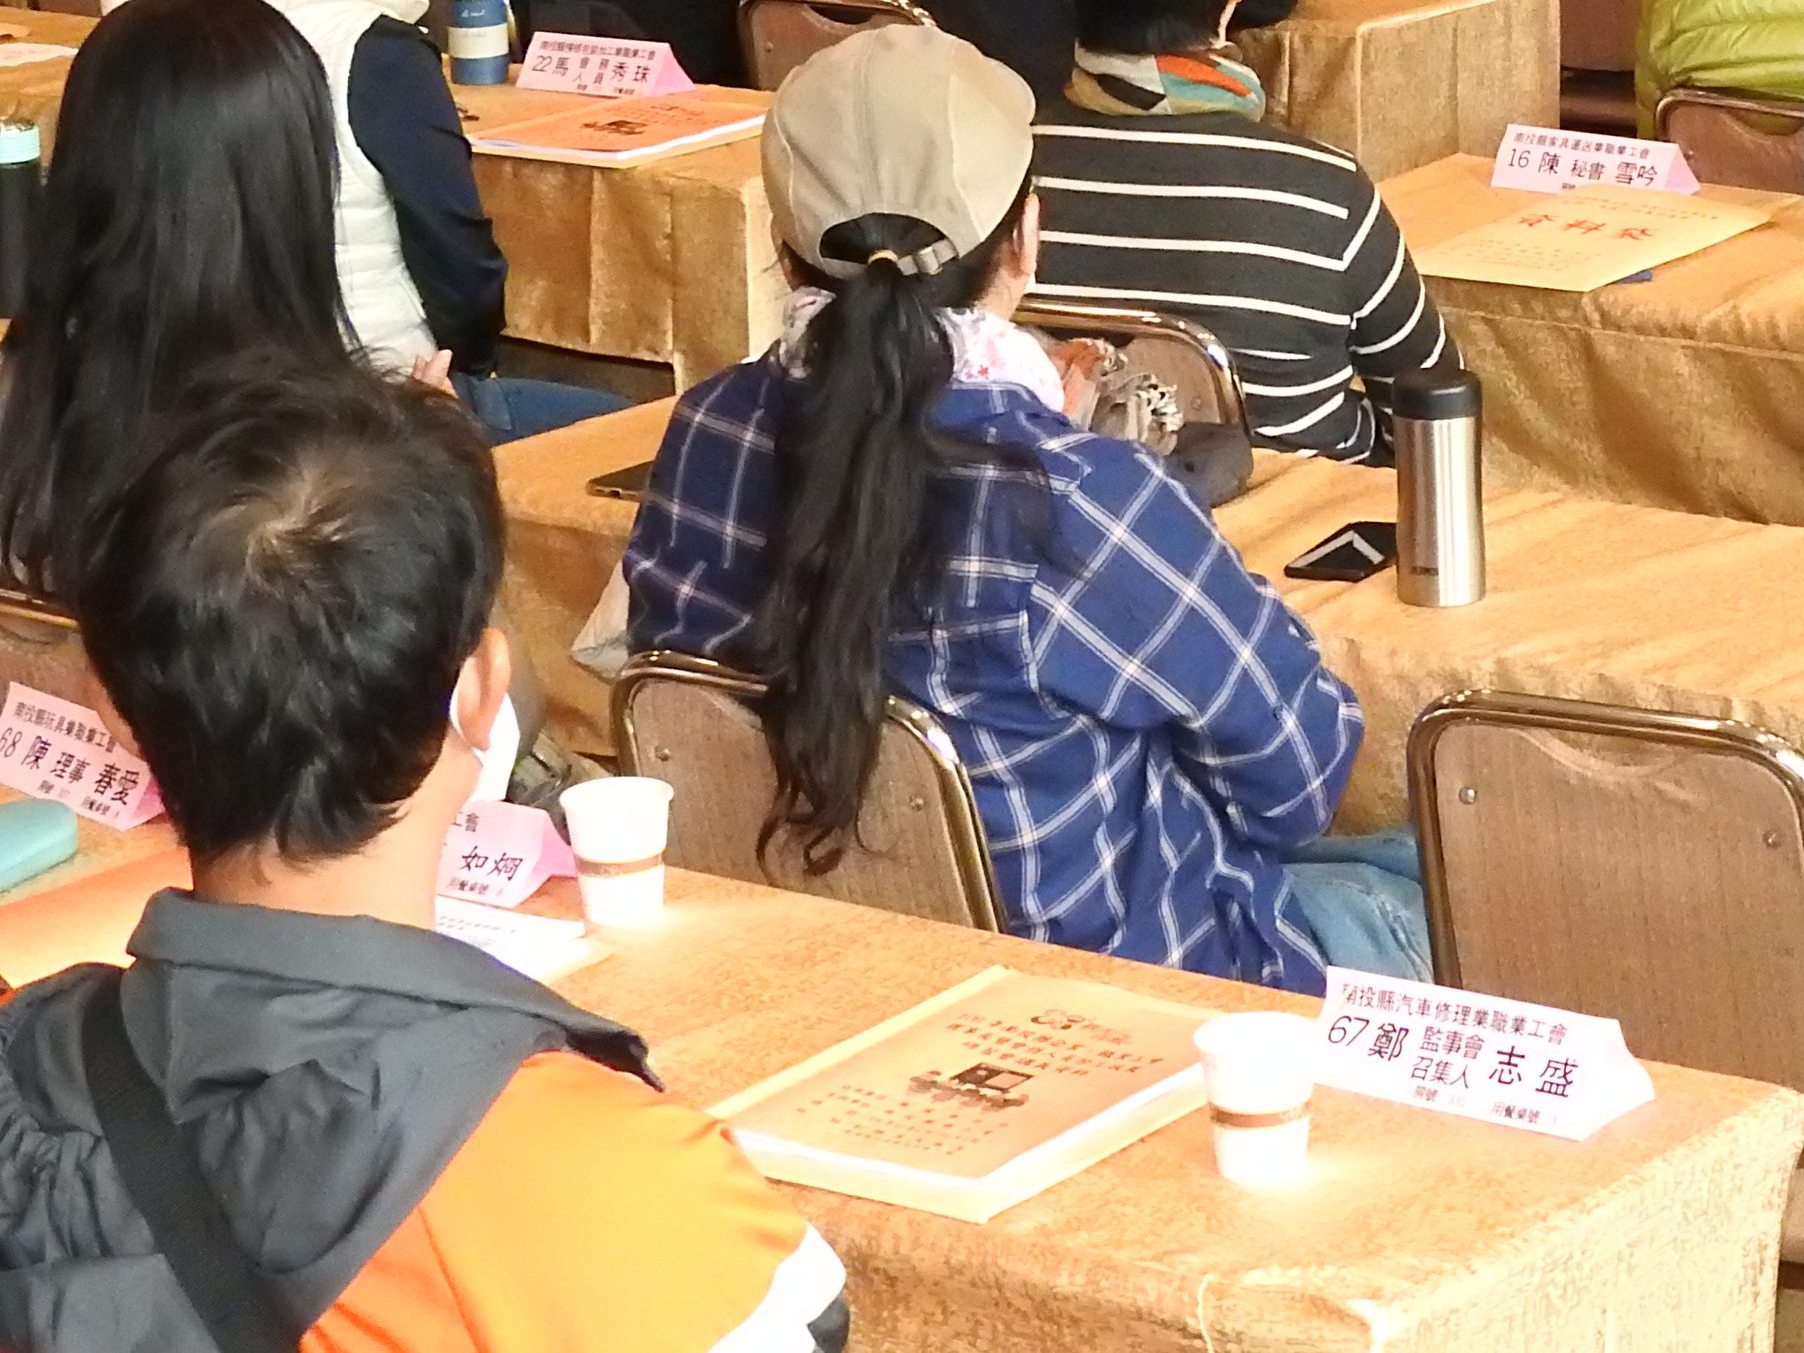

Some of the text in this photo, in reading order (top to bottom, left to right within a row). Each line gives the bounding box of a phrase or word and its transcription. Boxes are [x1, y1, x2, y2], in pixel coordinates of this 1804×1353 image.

[532, 55, 553, 72] 22
[552, 57, 570, 77] 馬
[1508, 148, 1658, 187] 16 陳 秘書 雪吟
[21, 735, 52, 770] 陳
[50, 751, 91, 784] 理事
[1342, 983, 1568, 1045] 南投縣汽車修理業職業工會
[1328, 1015, 1369, 1047] 67
[1367, 1022, 1409, 1062] 鄭
[1419, 1026, 1485, 1060] 監事會
[1410, 1056, 1469, 1089] 召集人
